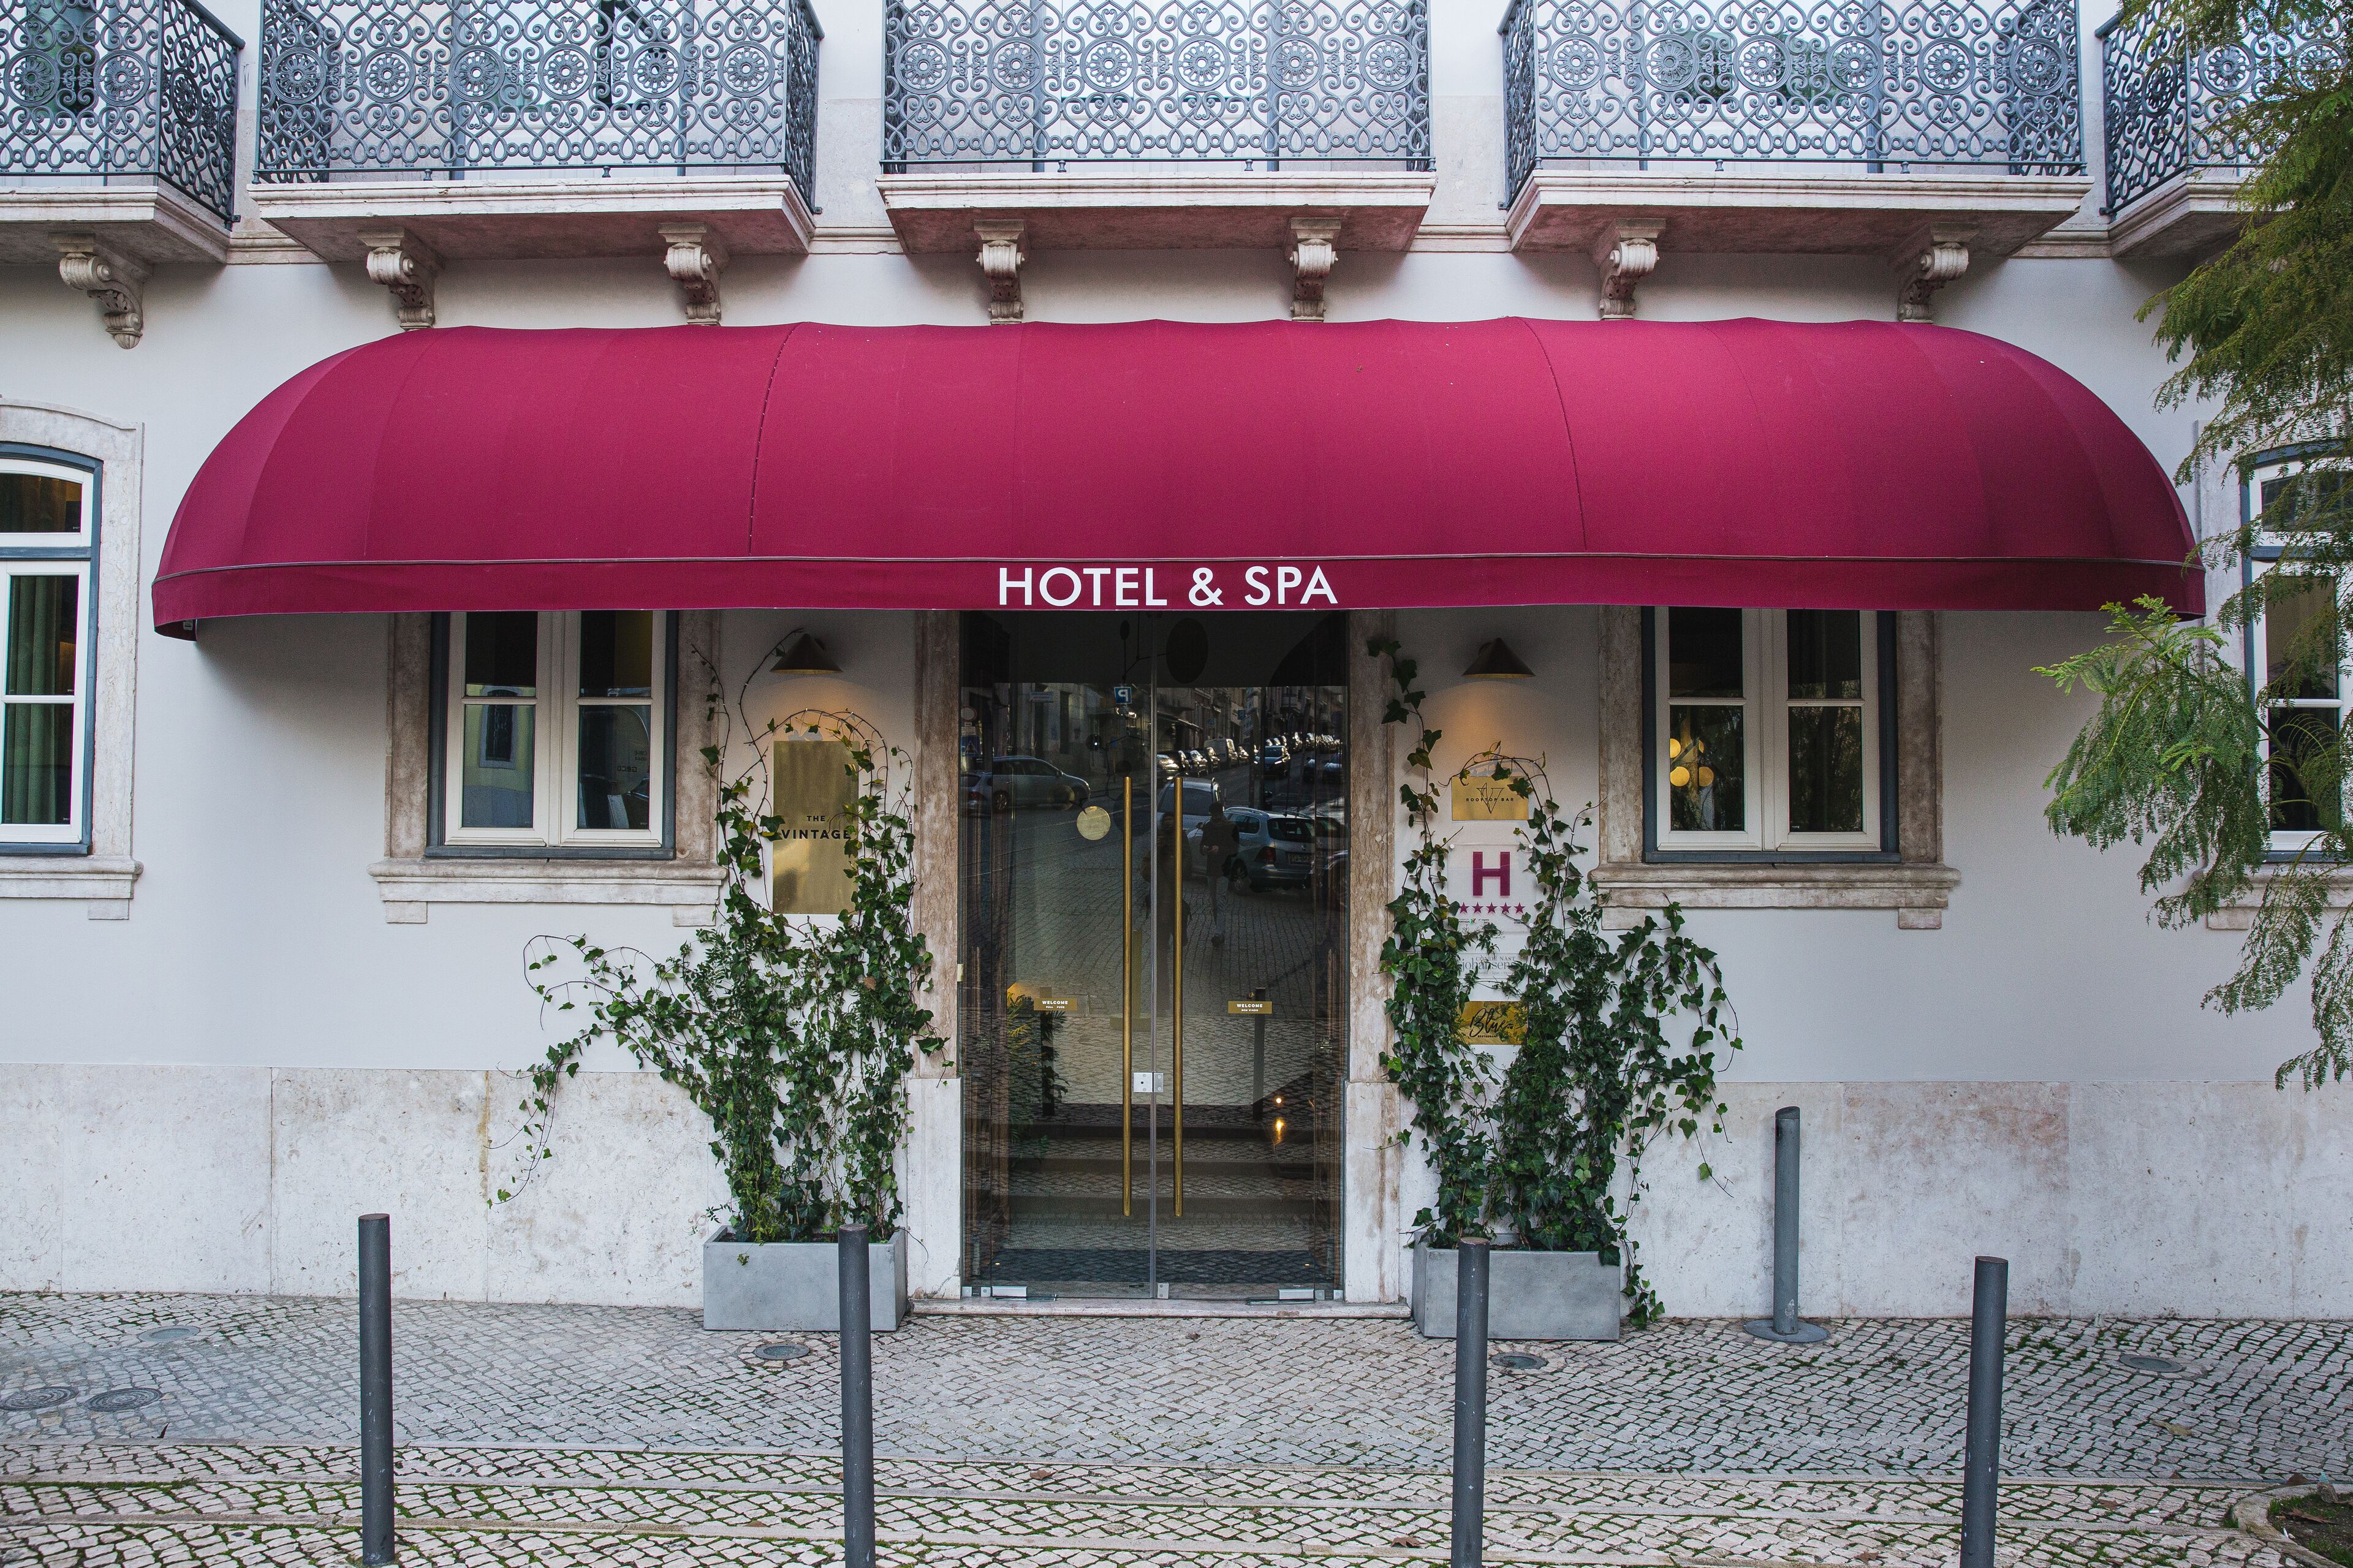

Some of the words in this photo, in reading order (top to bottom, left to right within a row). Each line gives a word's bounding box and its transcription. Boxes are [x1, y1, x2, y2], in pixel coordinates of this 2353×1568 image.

[999, 567, 1167, 607] HOTEL
[1188, 567, 1224, 606] &
[1245, 565, 1338, 605] SPA
[781, 829, 851, 839] VINTAGE
[1473, 851, 1510, 896] H
